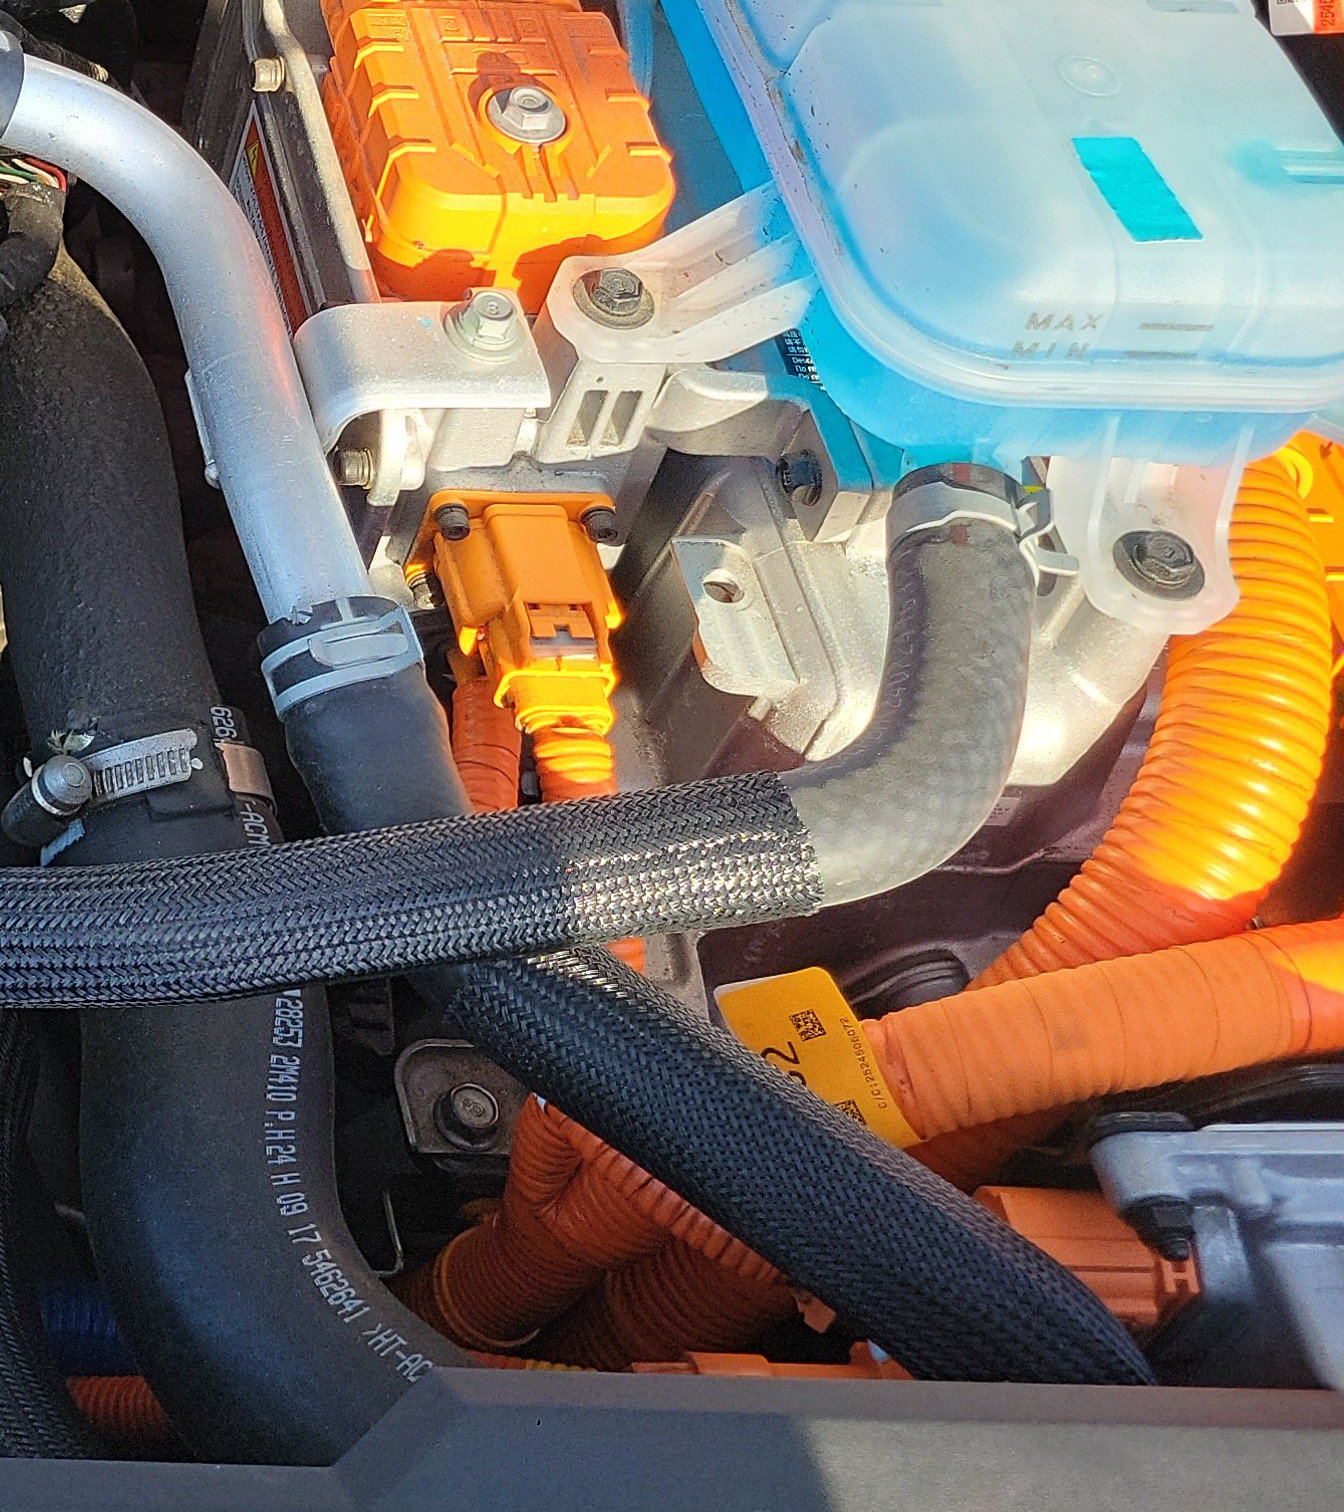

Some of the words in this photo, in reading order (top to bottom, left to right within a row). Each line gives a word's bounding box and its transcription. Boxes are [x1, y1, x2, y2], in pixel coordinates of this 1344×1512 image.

[1025, 311, 1104, 332] MAX
[1010, 340, 1091, 360] MIN
[272, 993, 302, 1050] 28253
[276, 1191, 309, 1217] 09
[287, 1222, 322, 1245] 17
[301, 1250, 370, 1323] 5462641
